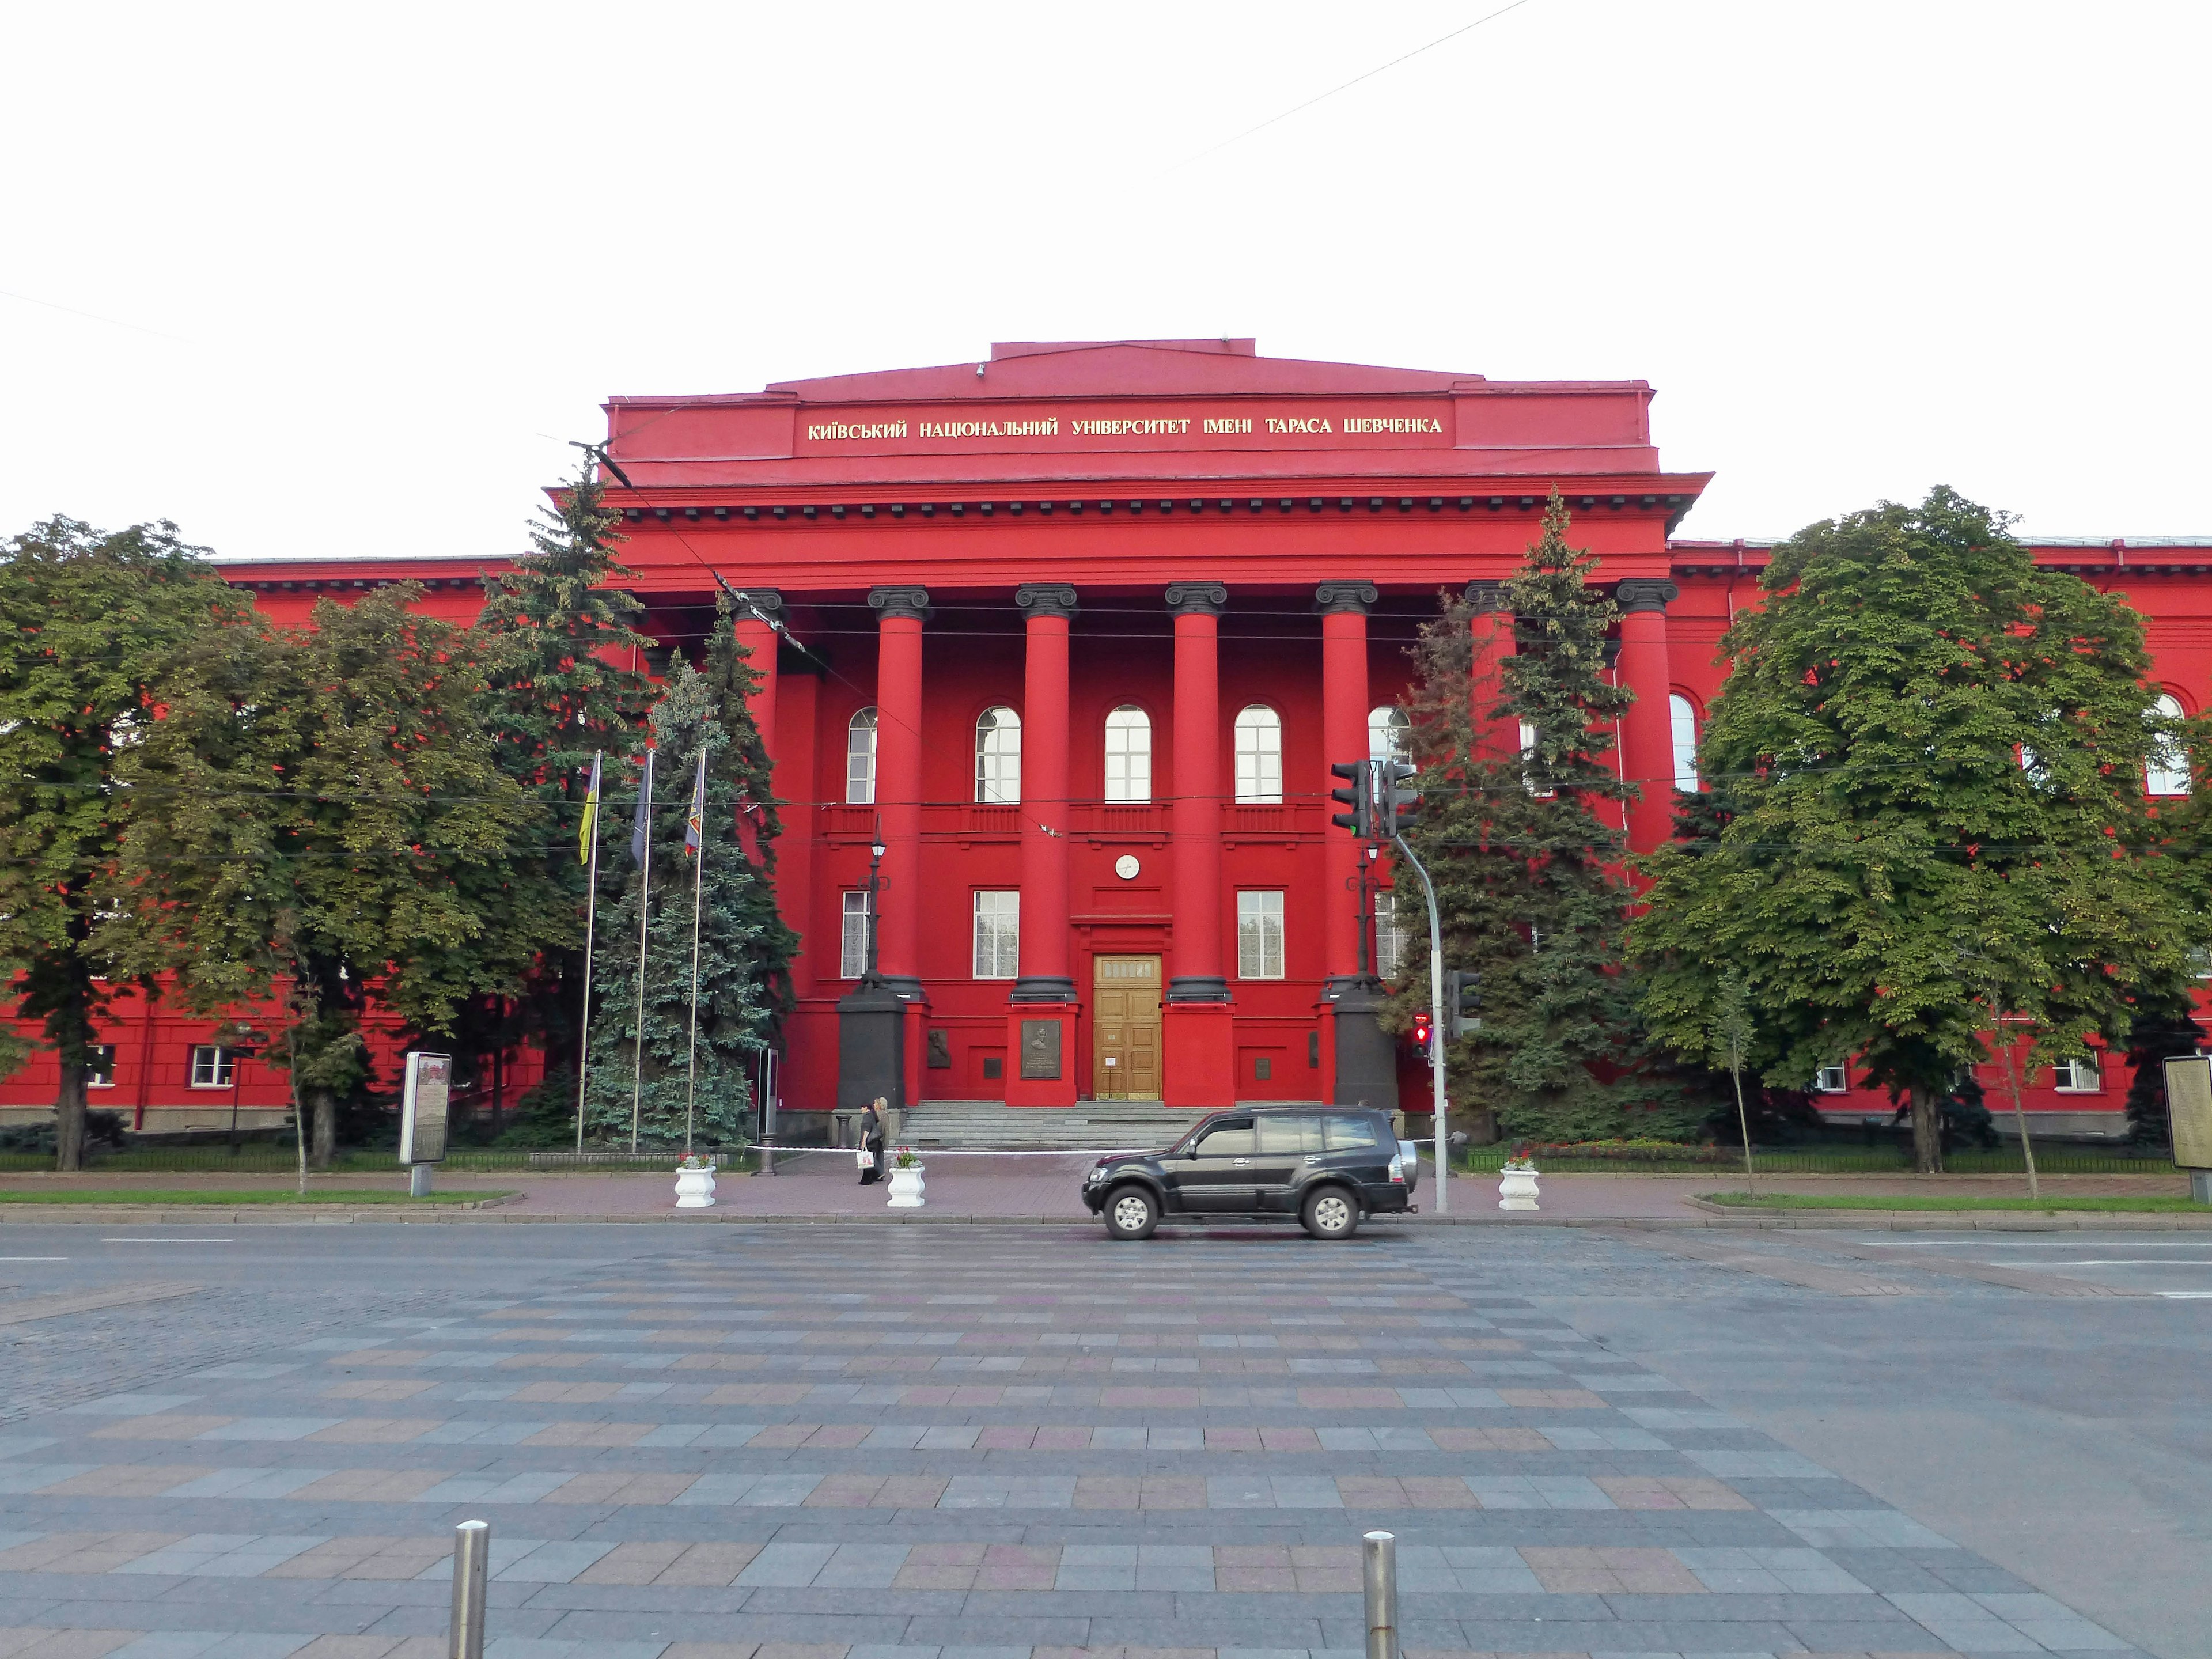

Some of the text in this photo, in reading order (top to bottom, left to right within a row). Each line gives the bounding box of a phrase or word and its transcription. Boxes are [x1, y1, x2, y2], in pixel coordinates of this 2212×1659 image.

[808, 417, 1443, 440] КИЇВСЬКИЙ НАЦІОНАЛЬНИЙ УНІВЕРСИТЕТ ІМЕНІ ТАРАСА ШЕВЧЕНКА
